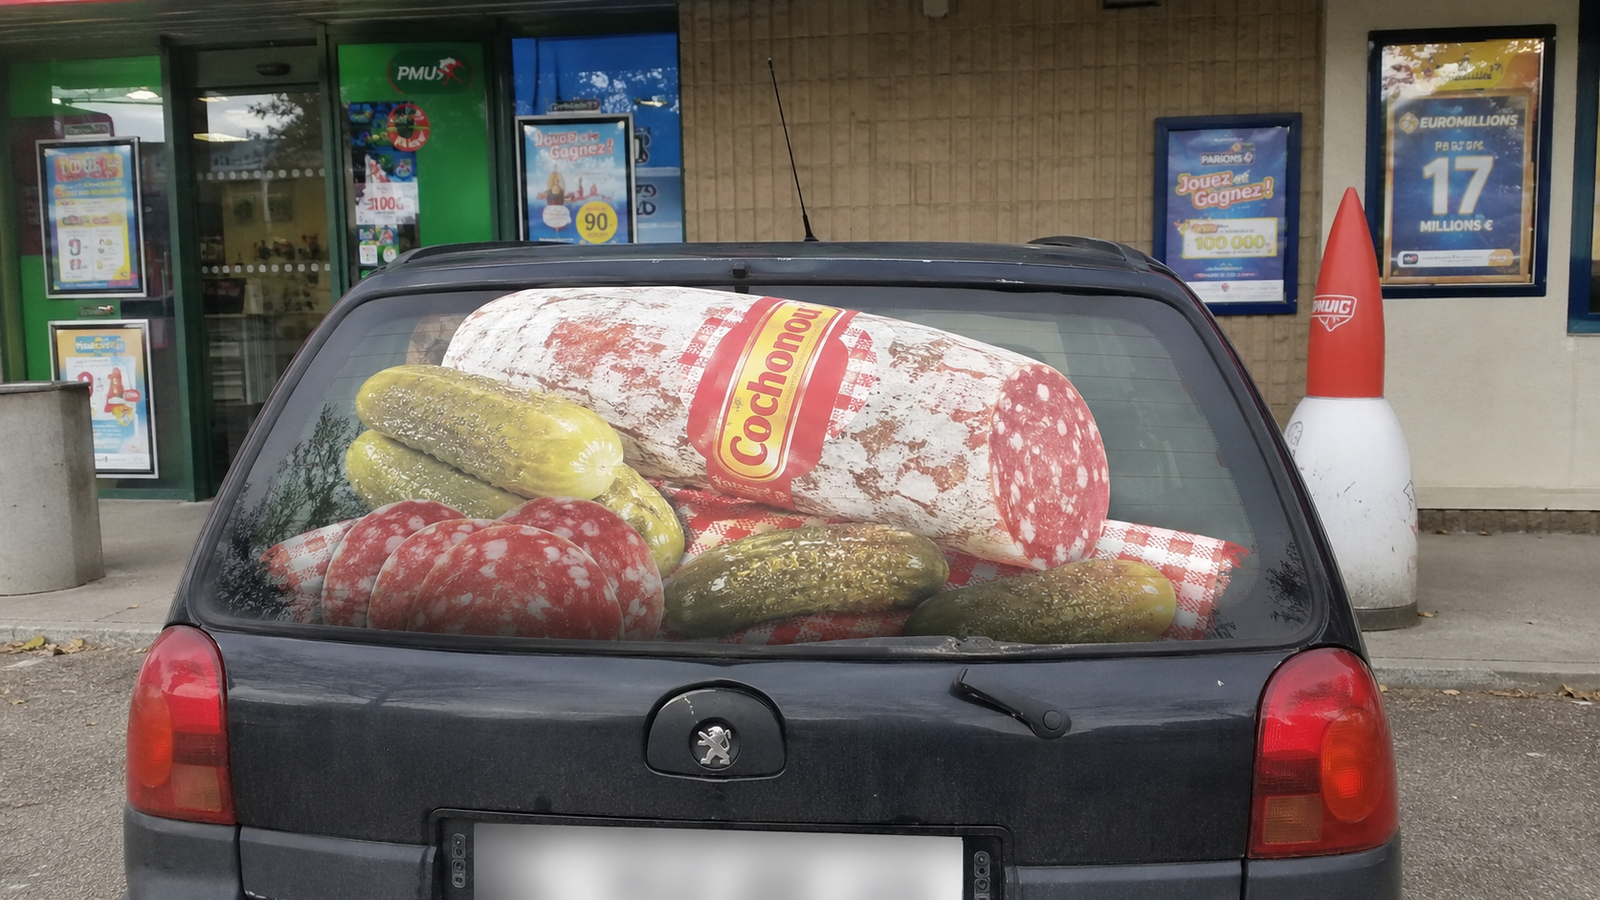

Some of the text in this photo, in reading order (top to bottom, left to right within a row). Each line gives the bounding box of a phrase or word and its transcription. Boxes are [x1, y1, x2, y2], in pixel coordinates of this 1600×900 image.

[397, 66, 437, 80] PMU
[1419, 115, 1519, 129] EUROMILLIONS
[1179, 174, 1230, 192] Jouez
[1423, 155, 1494, 215] 17
[585, 213, 608, 231] 90
[1420, 220, 1493, 232] MILLIONS €
[1195, 235, 1266, 250] 100 000
[730, 308, 823, 466] Cochonou
